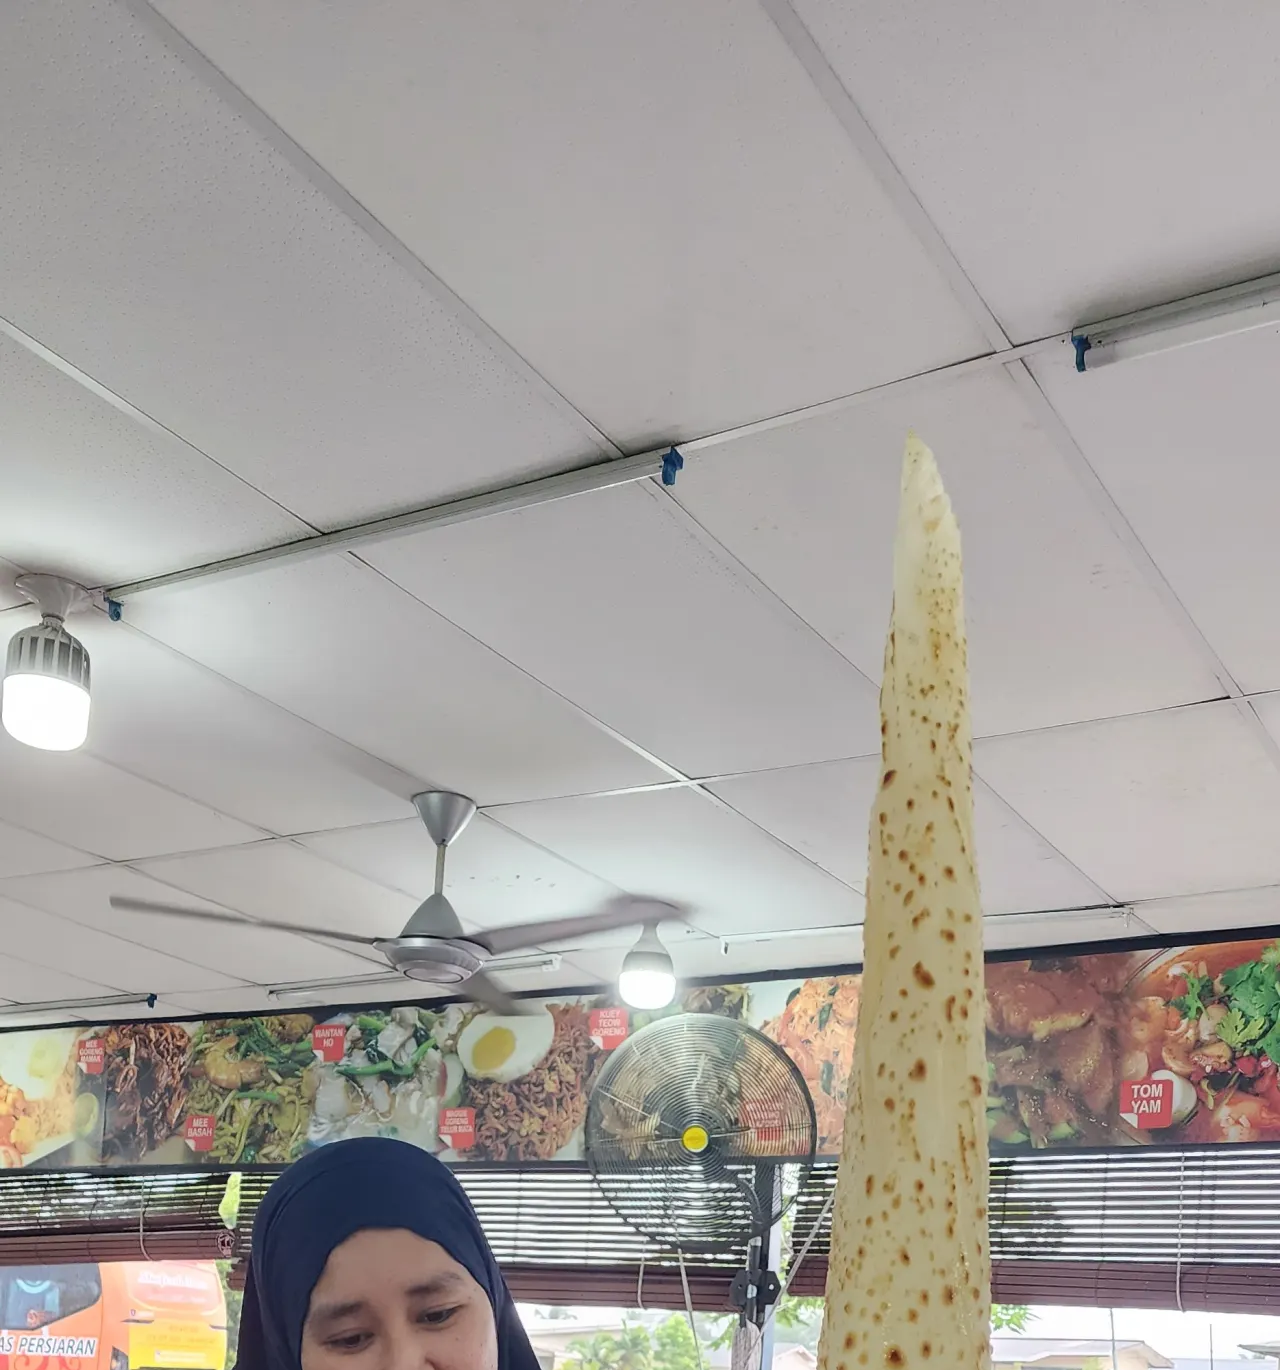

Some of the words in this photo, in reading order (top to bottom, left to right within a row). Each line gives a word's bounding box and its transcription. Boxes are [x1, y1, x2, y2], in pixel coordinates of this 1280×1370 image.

[600, 1010, 621, 1019] KUEY
[599, 1018, 621, 1028] TEOW
[315, 1028, 343, 1038] WANTAN
[592, 1027, 626, 1036] GORENG
[86, 1040, 98, 1048] MEE
[323, 1038, 334, 1048] HO
[1131, 1083, 1163, 1098] TOM
[1131, 1099, 1161, 1114] YAM
[192, 1118, 209, 1128] MEE
[187, 1128, 213, 1138] BASAH
[18, 1337, 96, 1355] PERSIARAN
